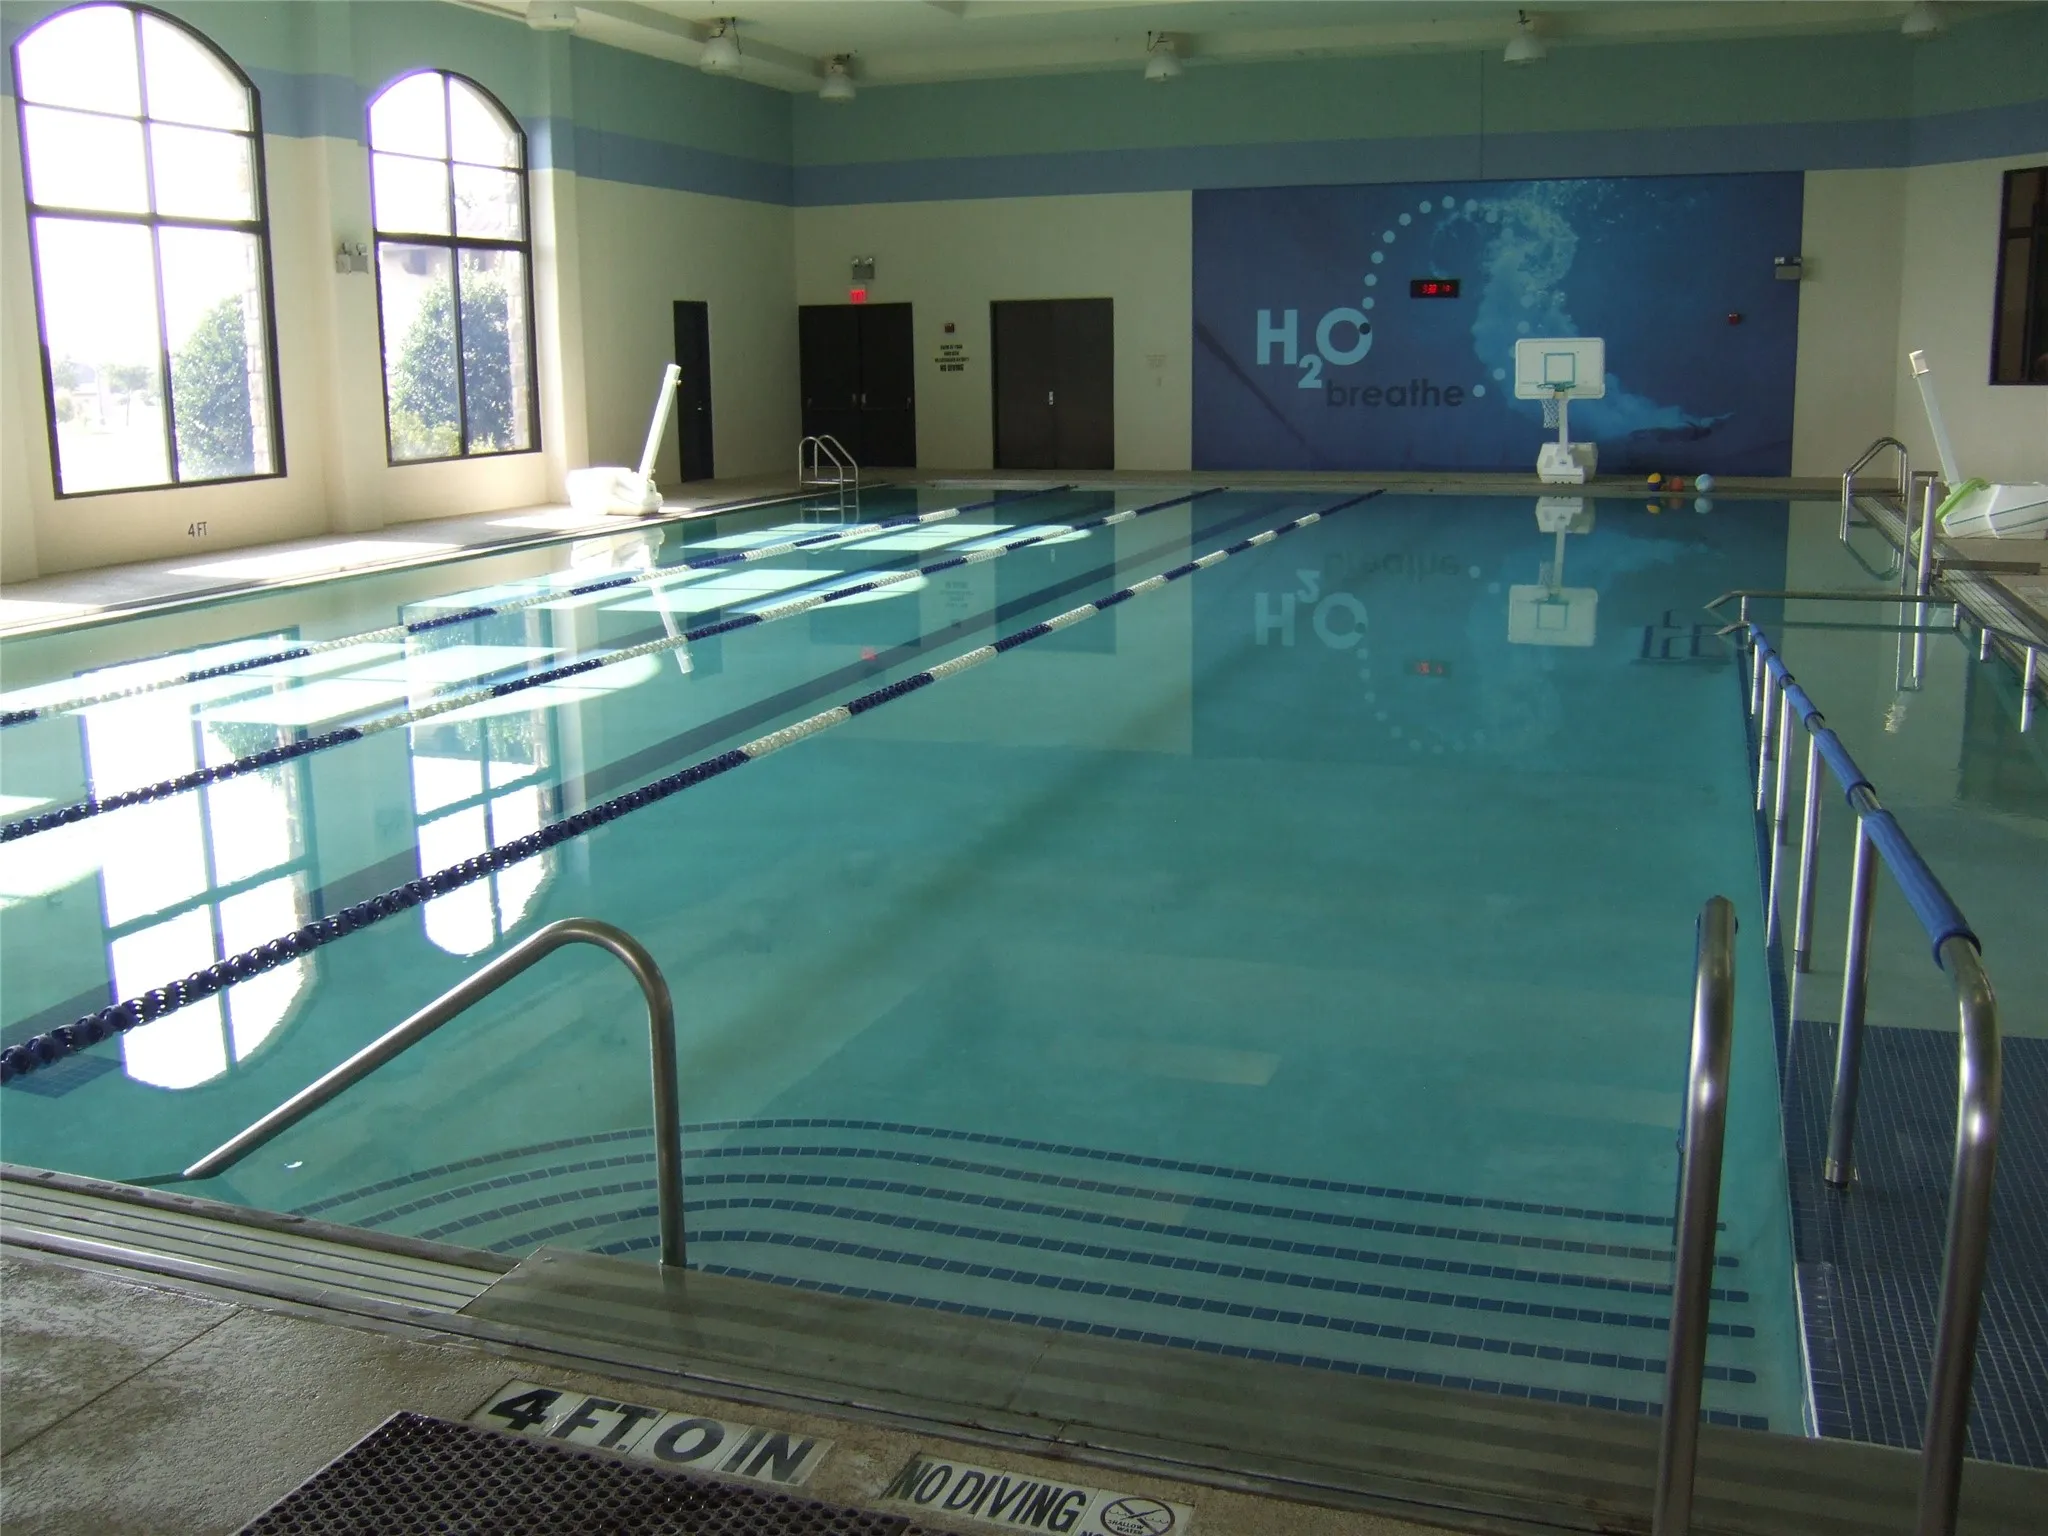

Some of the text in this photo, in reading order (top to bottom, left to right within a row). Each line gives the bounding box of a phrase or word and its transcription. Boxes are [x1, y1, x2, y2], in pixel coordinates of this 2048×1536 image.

[1257, 307, 1373, 389] H2O
[1326, 379, 1465, 407] breathe
[188, 521, 207, 537] 4 FT
[489, 1388, 563, 1431] 4
[720, 1427, 815, 1482] IN
[895, 1459, 1087, 1533] NO DIVING
[1107, 1519, 1146, 1530] SHALLOW
[1116, 1526, 1144, 1536] WATER
